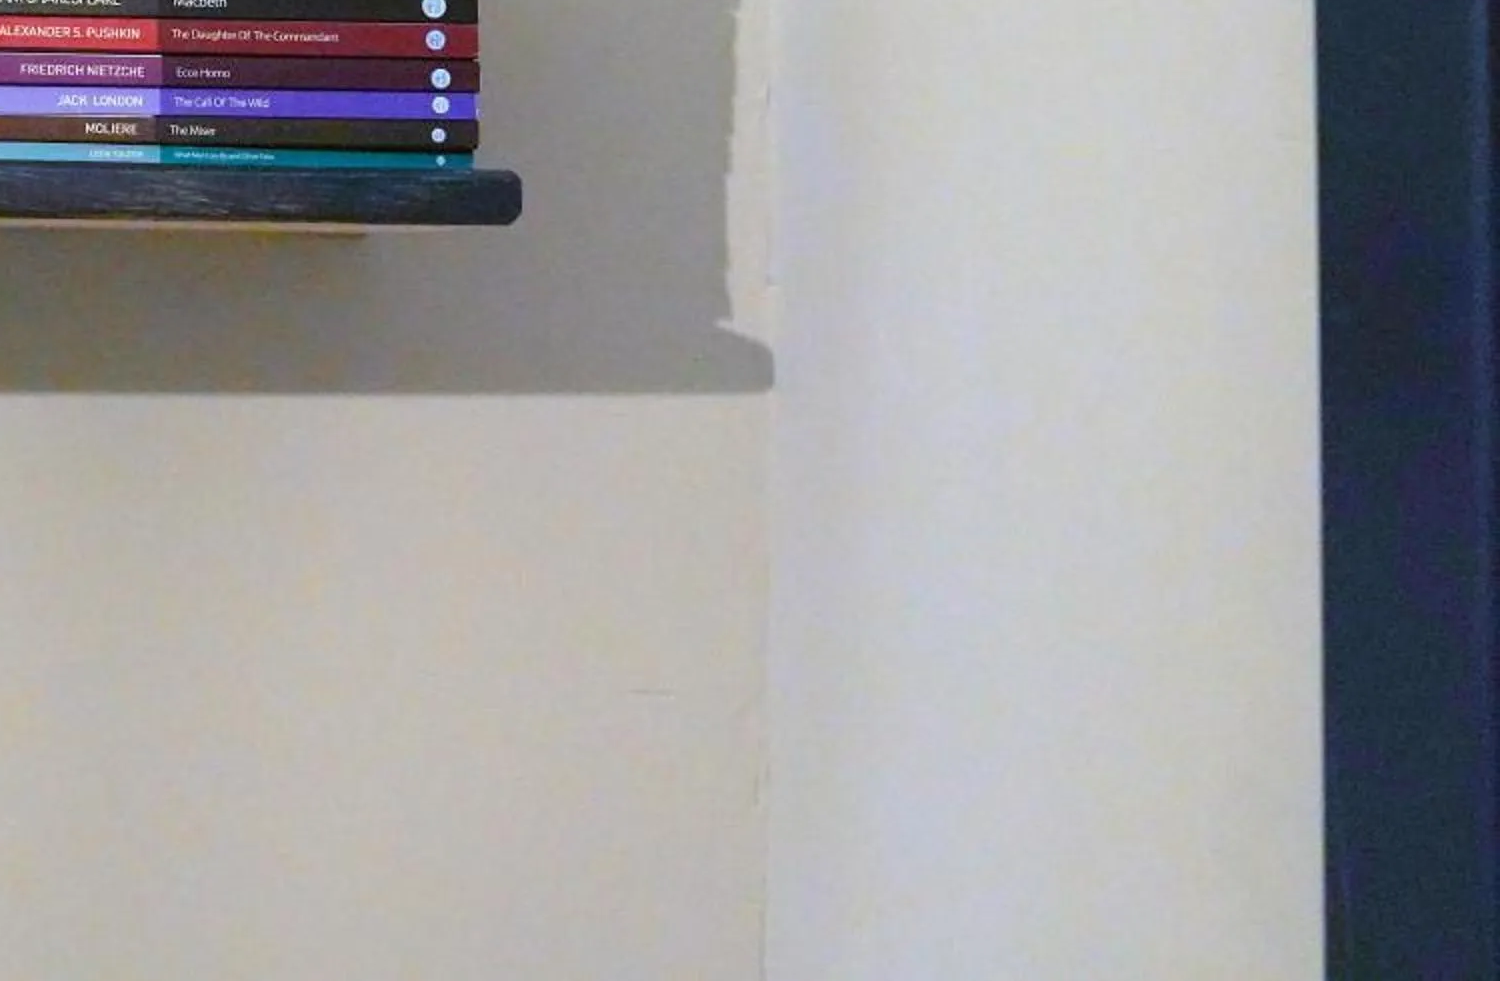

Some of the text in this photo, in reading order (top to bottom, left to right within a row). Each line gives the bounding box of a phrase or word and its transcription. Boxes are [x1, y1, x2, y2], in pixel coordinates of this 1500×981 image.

[0, 25, 73, 39] ALEXANDER
[86, 27, 141, 40] PUSHKIN
[172, 29, 340, 44] The Daughter Of The Commandant
[20, 63, 84, 76] FRIEDRICH
[200, 68, 231, 79] Homo
[56, 94, 143, 108] JACK LONDON
[173, 97, 270, 109] The Call Of The Wild
[169, 124, 188, 136] The
